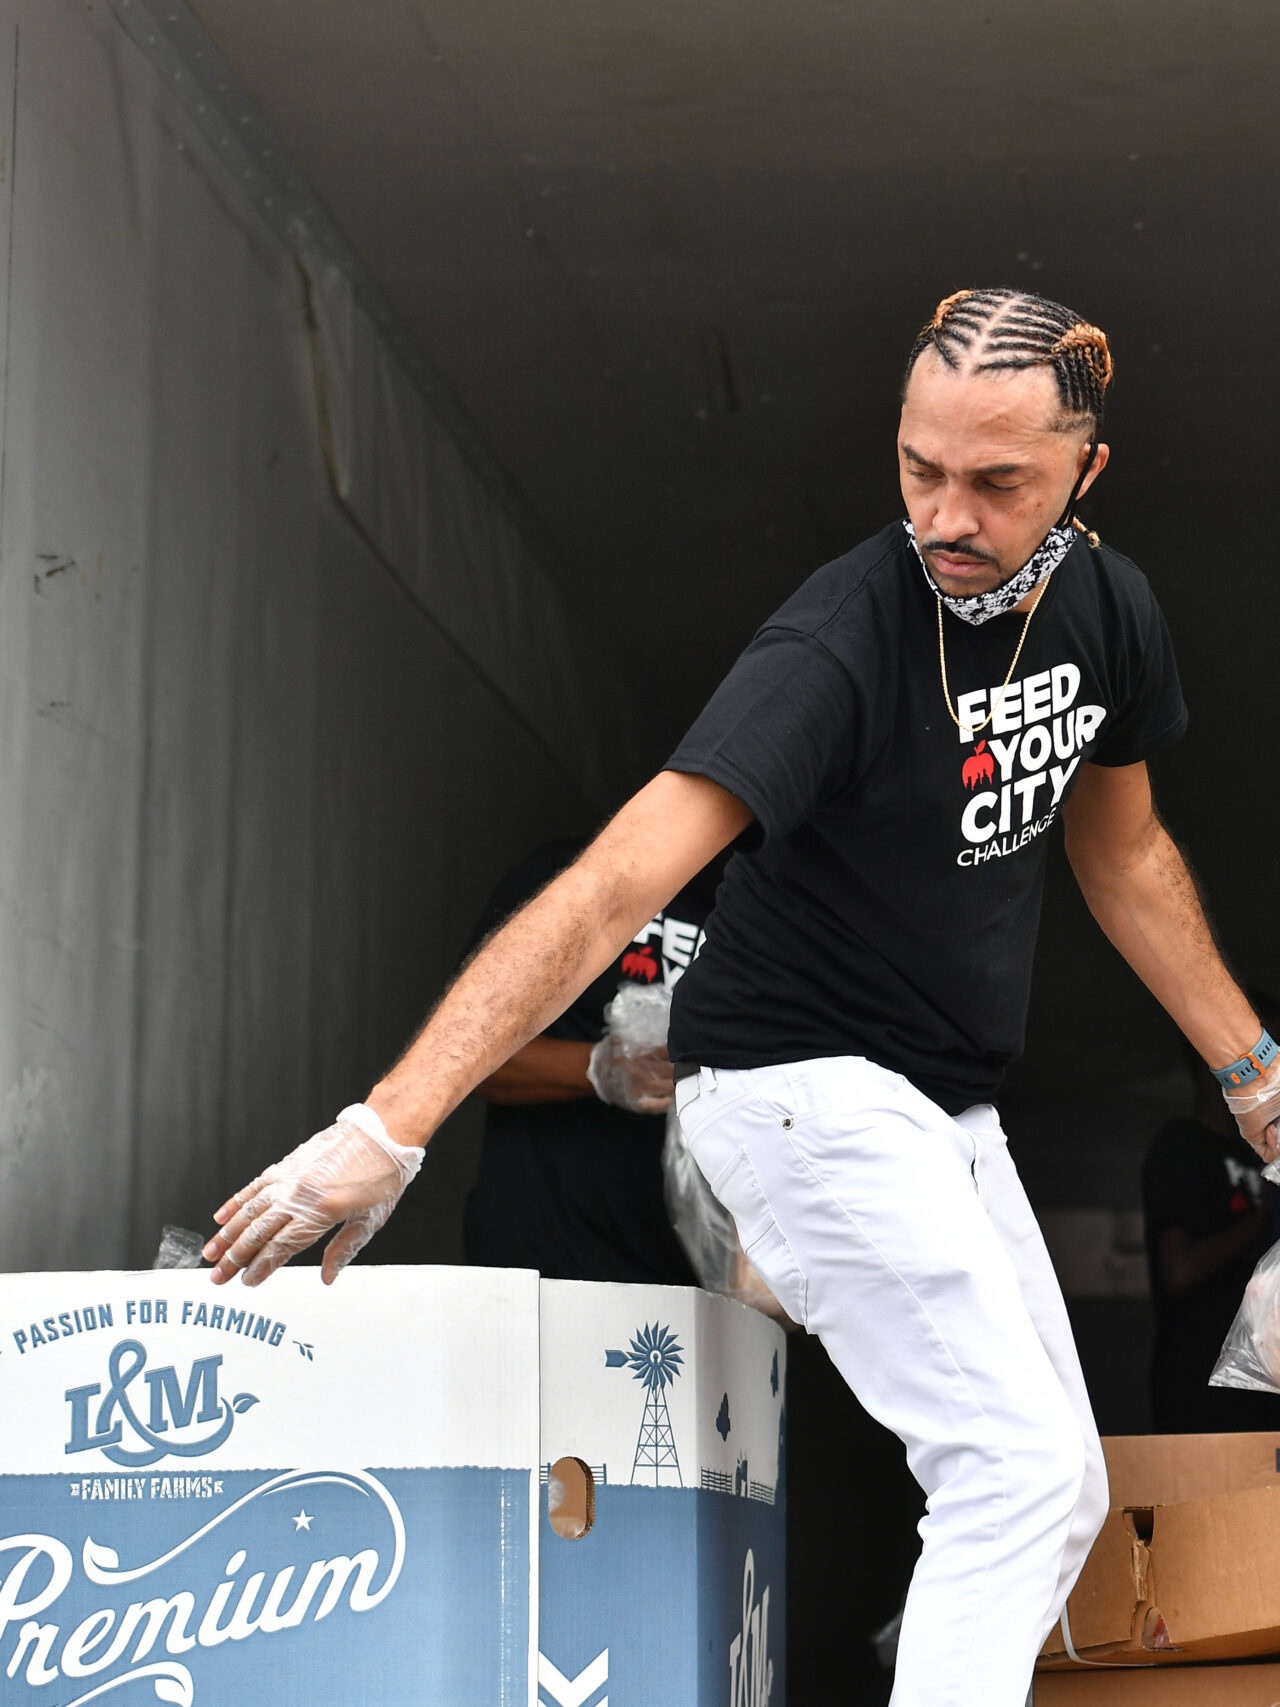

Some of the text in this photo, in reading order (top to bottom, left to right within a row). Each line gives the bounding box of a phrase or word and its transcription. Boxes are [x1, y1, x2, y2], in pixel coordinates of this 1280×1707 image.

[957, 662, 1081, 744] FEED
[987, 704, 1107, 782] YOUR
[957, 806, 1056, 867] CHALLENGE
[961, 755, 1081, 843] CITY
[13, 1299, 286, 1354] PASSION FOR FARMING
[65, 1339, 234, 1468] L&M
[82, 1477, 213, 1500] FAMILY FARMS
[0, 1534, 405, 1686] Premium
